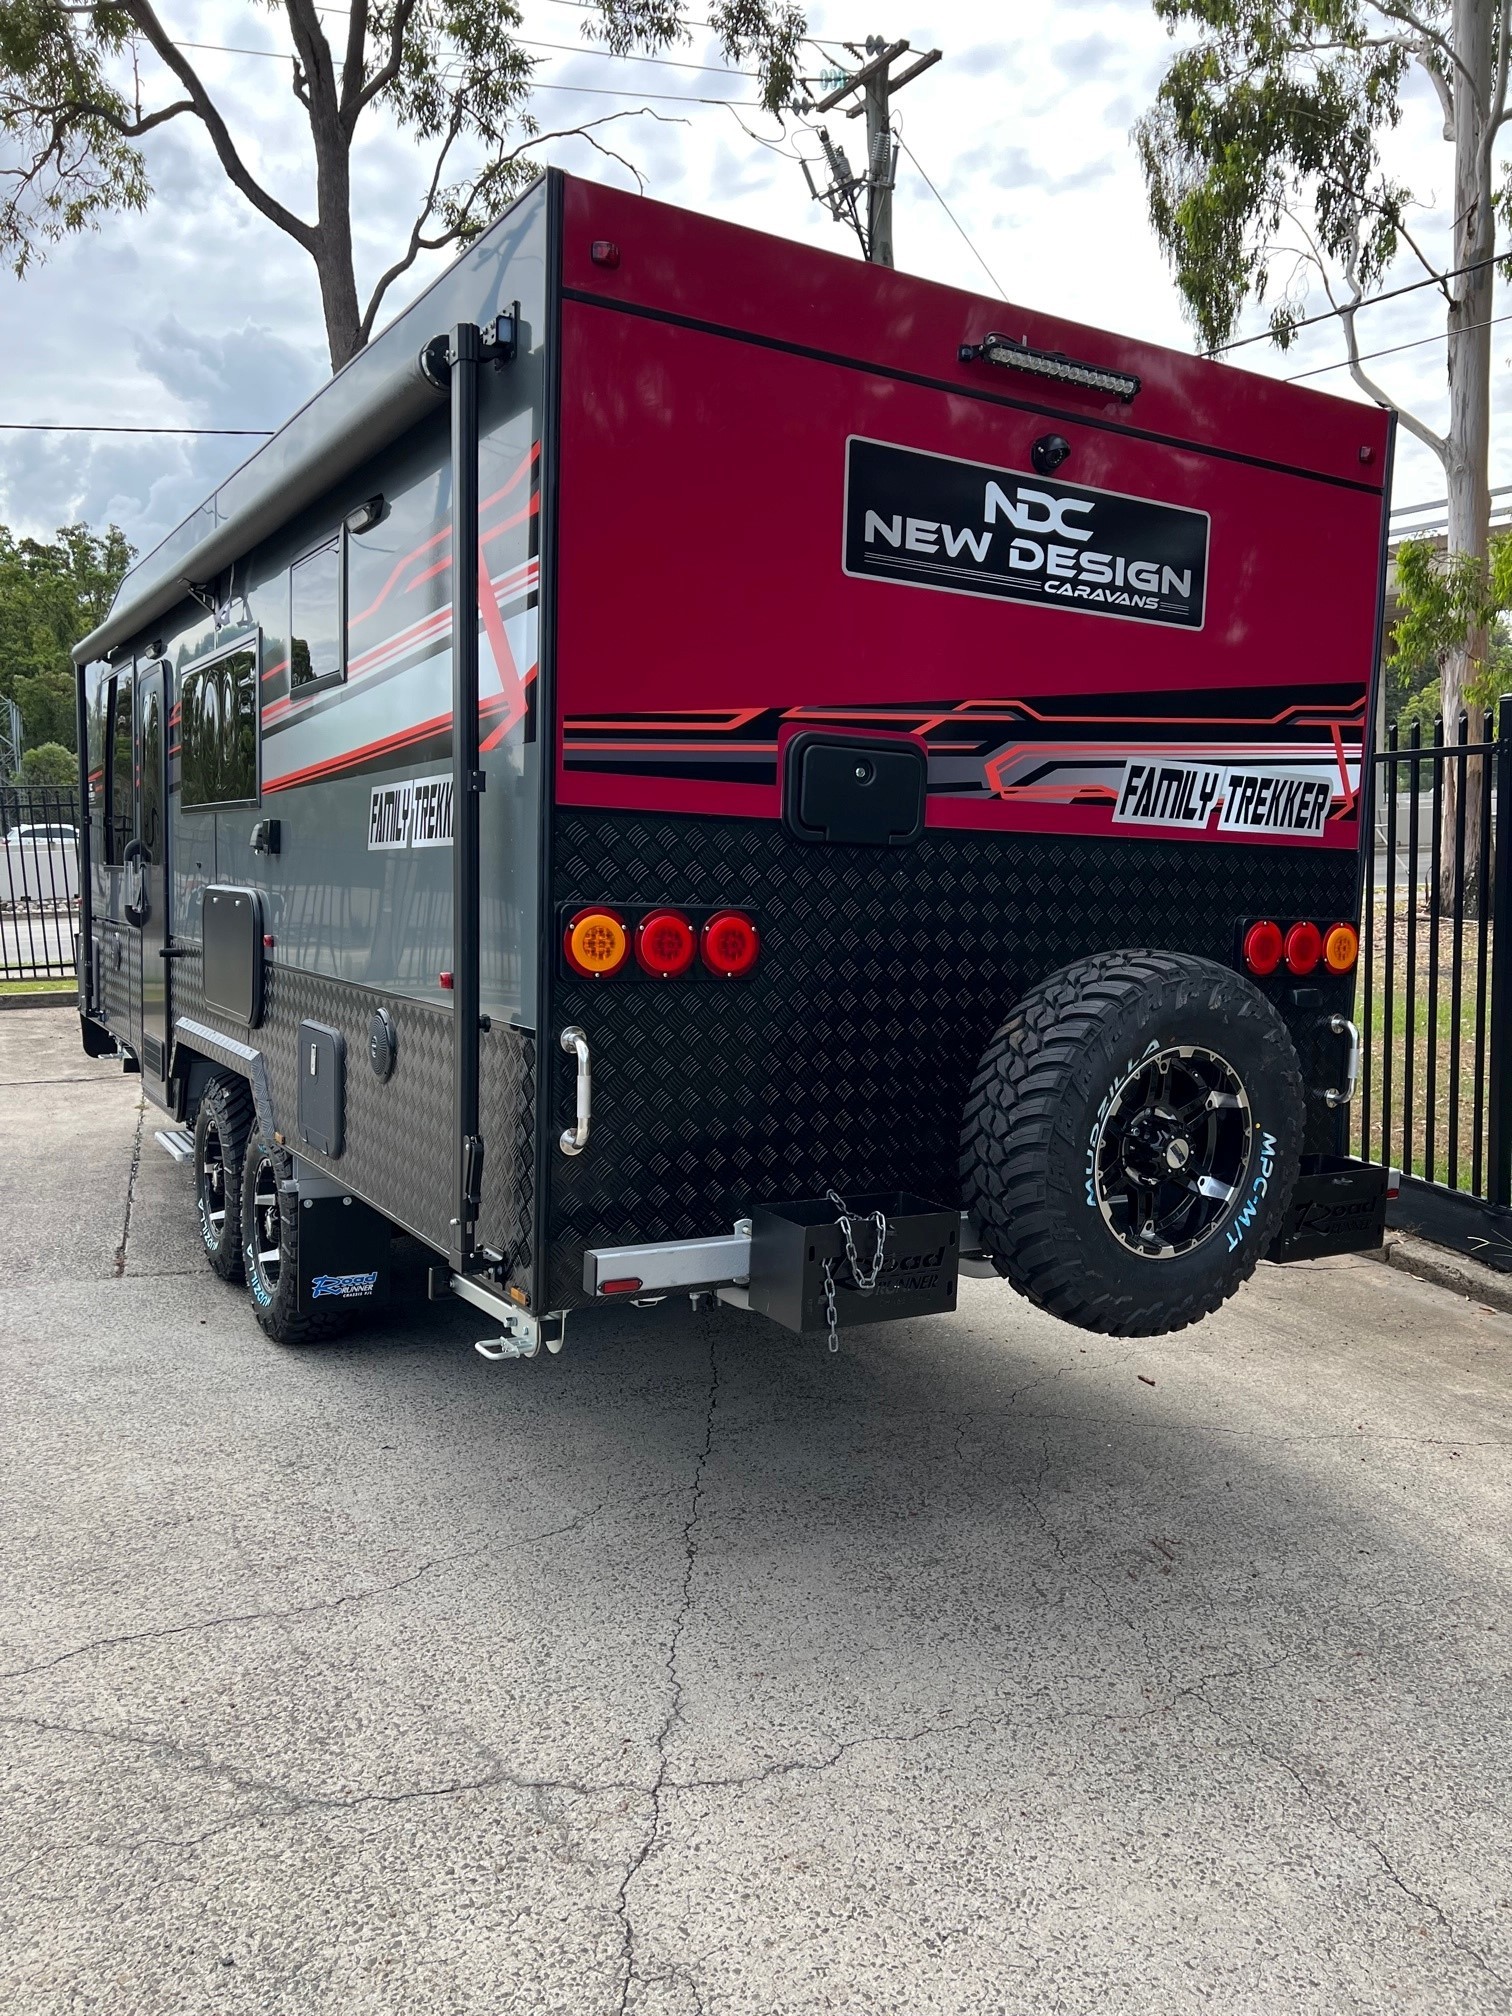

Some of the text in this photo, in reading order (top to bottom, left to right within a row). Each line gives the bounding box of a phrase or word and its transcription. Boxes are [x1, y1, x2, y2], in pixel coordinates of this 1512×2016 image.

[984, 480, 1096, 542] NDC
[864, 509, 1192, 598] NEW DESIGN
[1043, 579, 1160, 610] CARAVANS
[369, 780, 454, 844] FAMILY TREKK
[1118, 764, 1331, 830] FAMILY TREKKER
[1225, 1131, 1278, 1253] MPC-M/T
[311, 1271, 378, 1299] Road
